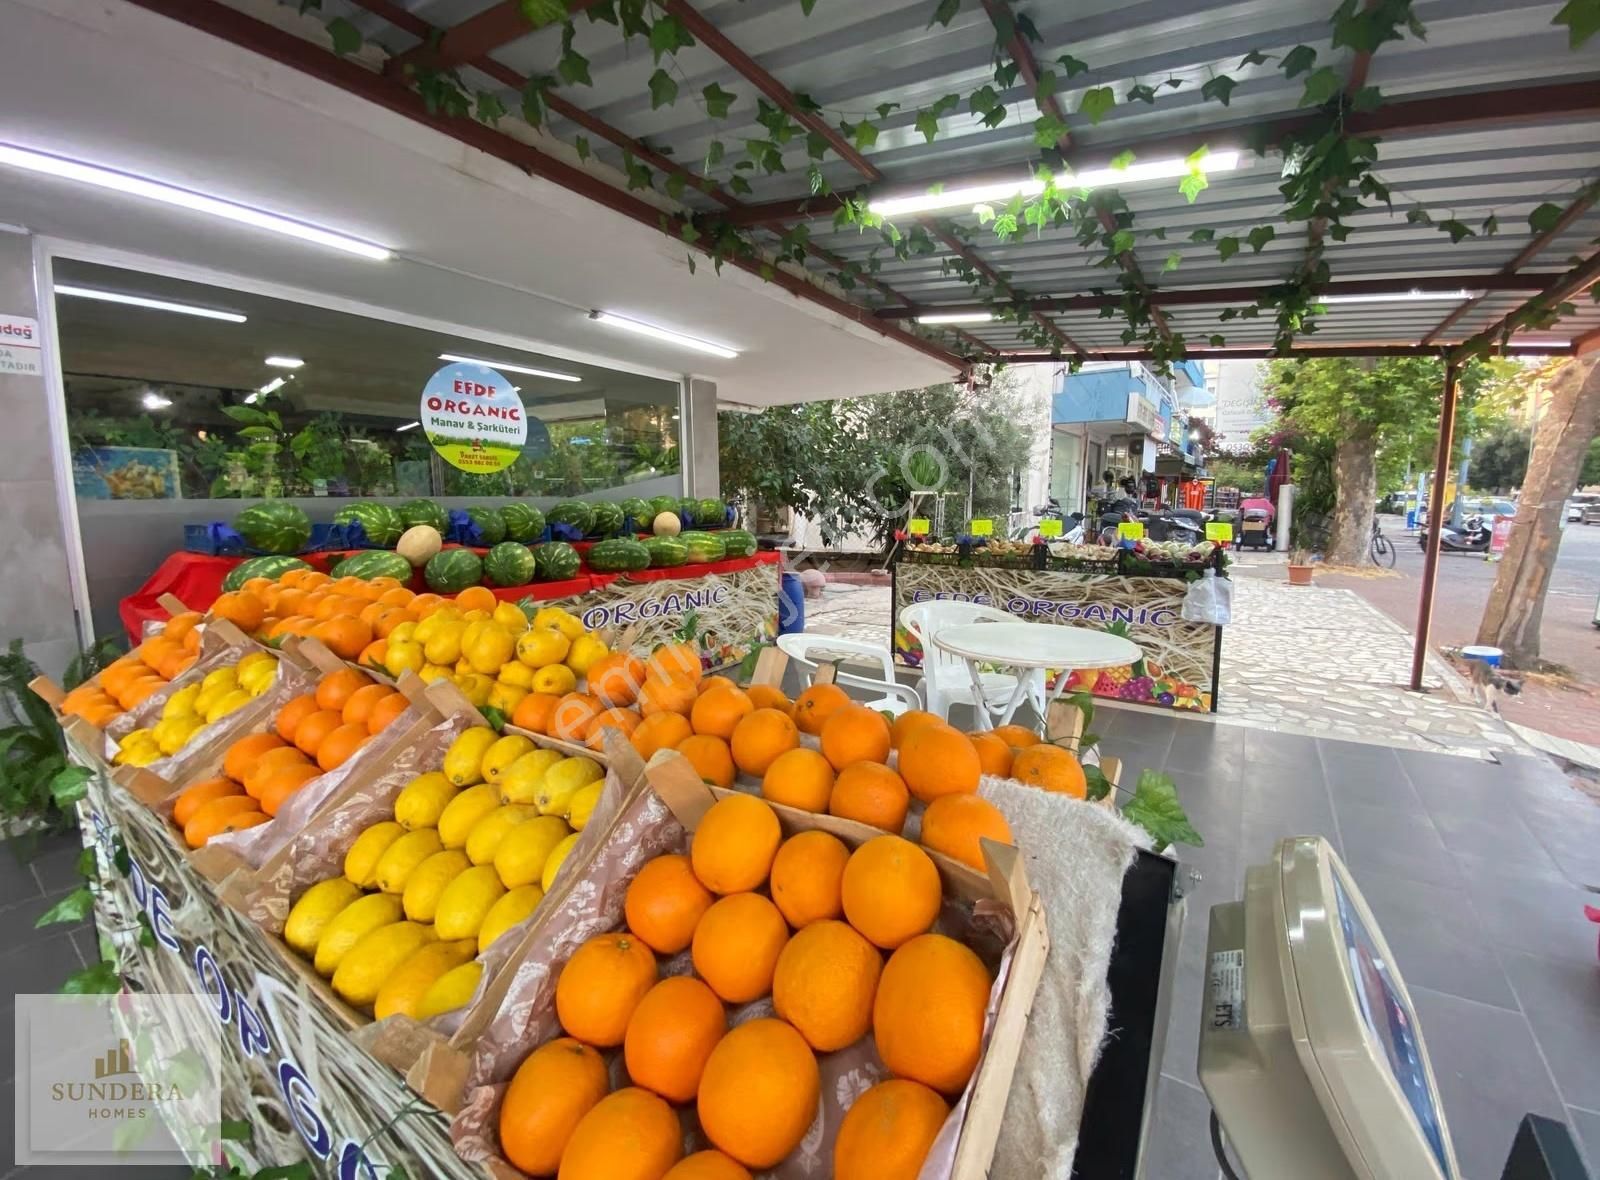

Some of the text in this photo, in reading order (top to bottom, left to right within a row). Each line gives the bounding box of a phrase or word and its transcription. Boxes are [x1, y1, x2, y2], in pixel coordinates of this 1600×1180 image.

[431, 417, 521, 435] Manav & Şarküteri
[582, 586, 728, 631] ORGANIC
[1006, 598, 1177, 629] ORGANIC
[1215, 1004, 1233, 1027] ETS
